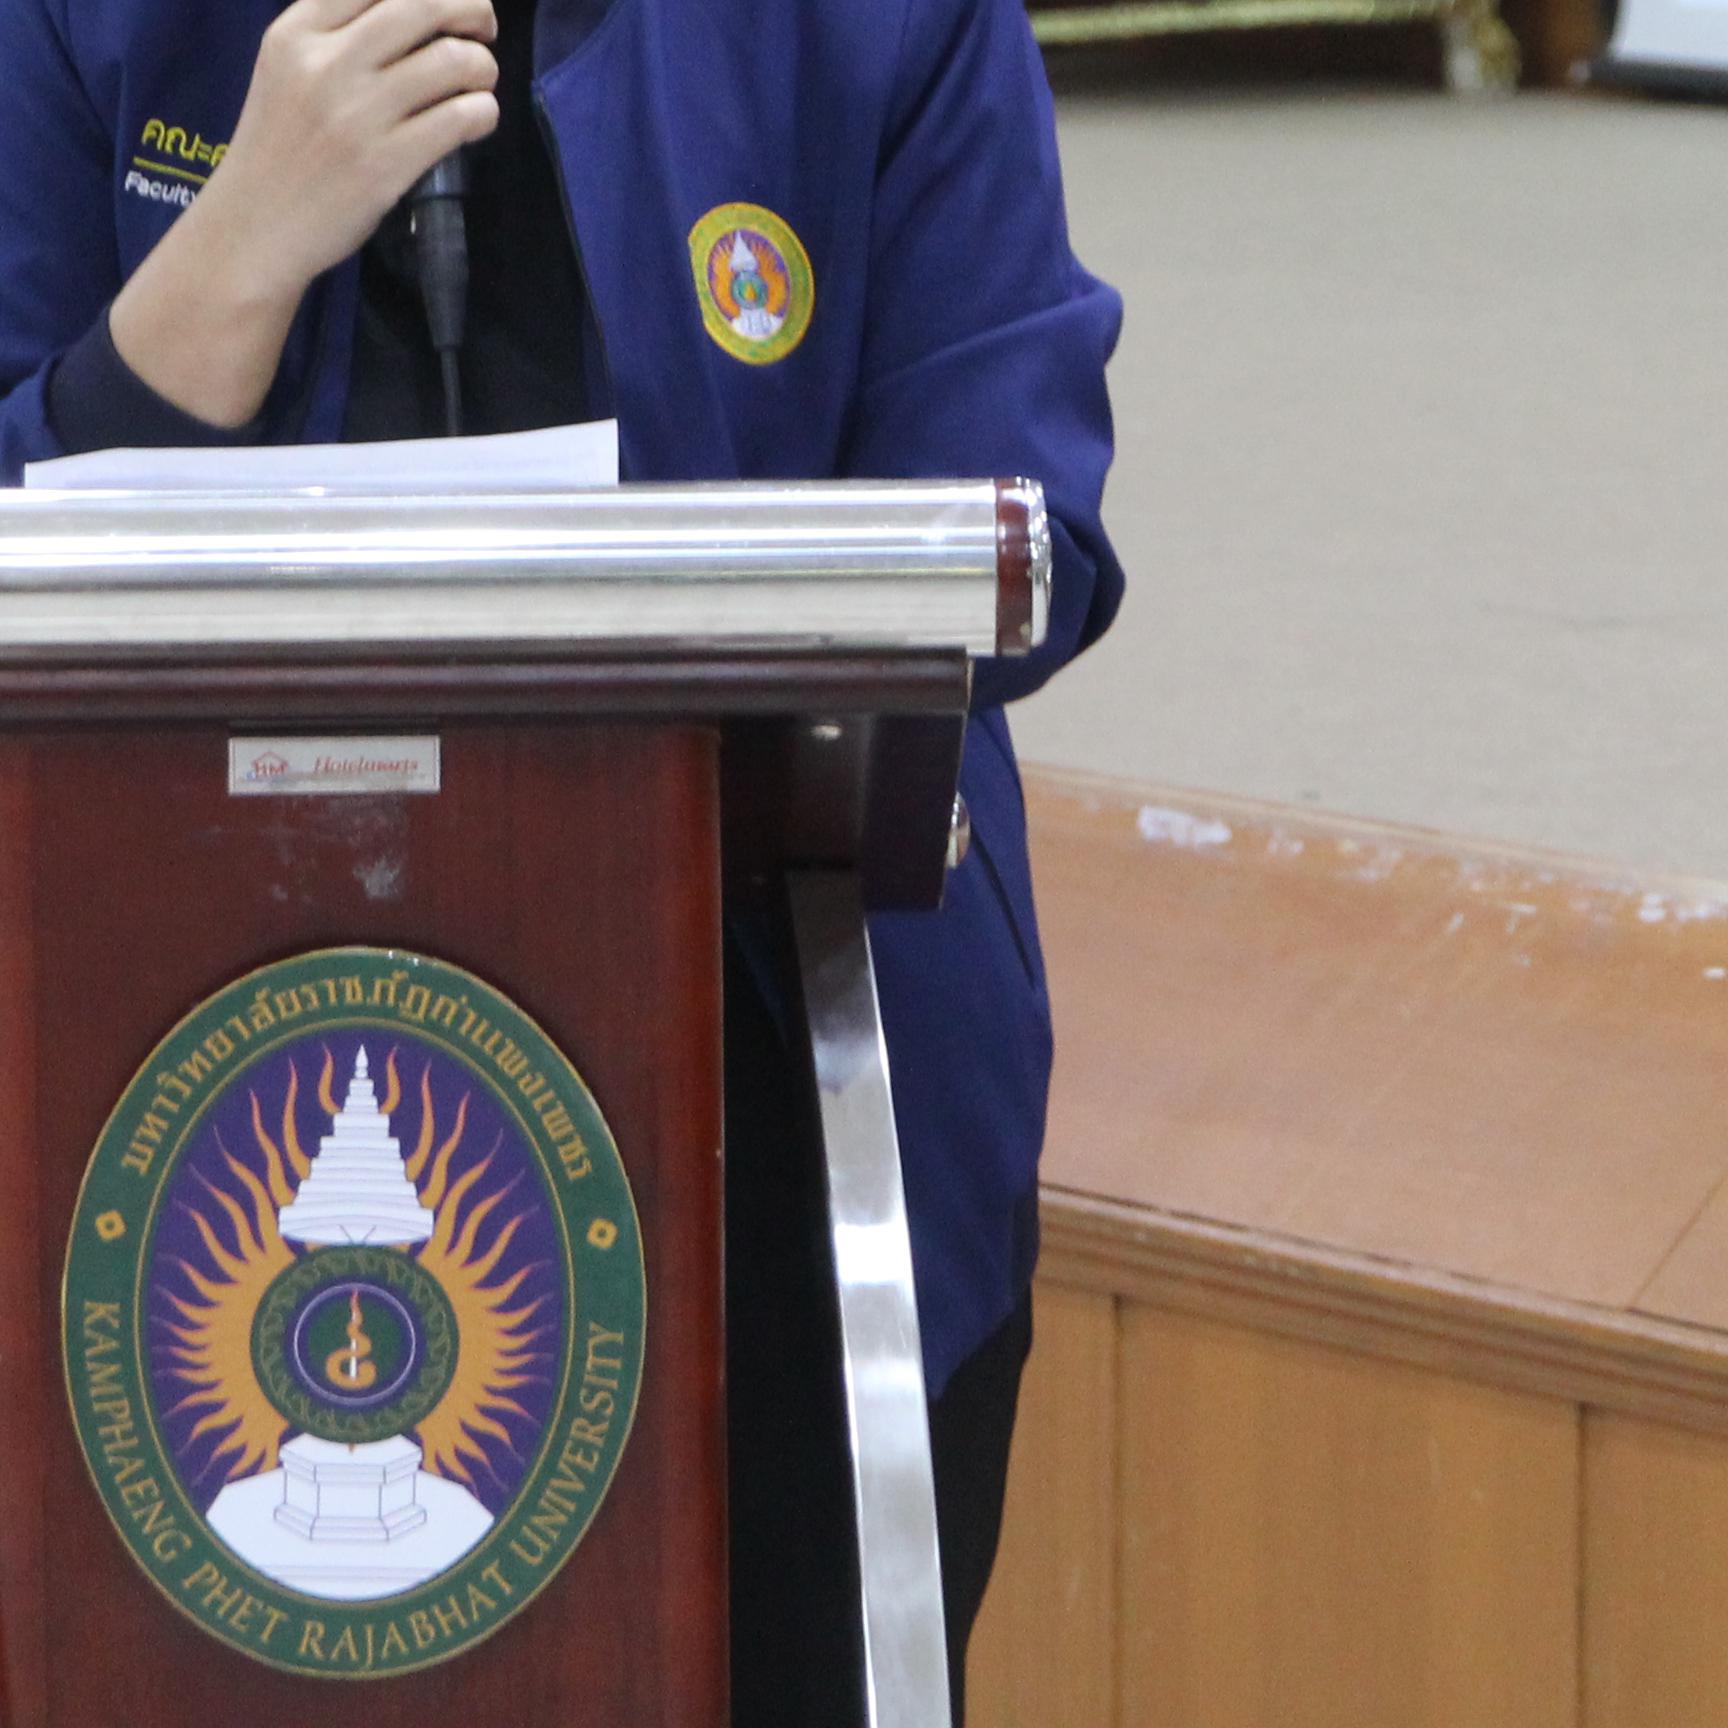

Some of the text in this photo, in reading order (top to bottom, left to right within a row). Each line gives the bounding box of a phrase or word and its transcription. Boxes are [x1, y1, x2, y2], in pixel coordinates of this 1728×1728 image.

[122, 970, 592, 1180] มหาวิทยาลัยราชภัฏกำแพงเพชร
[83, 1299, 624, 1668] KAMPHAENG PHET RAJABHAT UNIVERSITY
